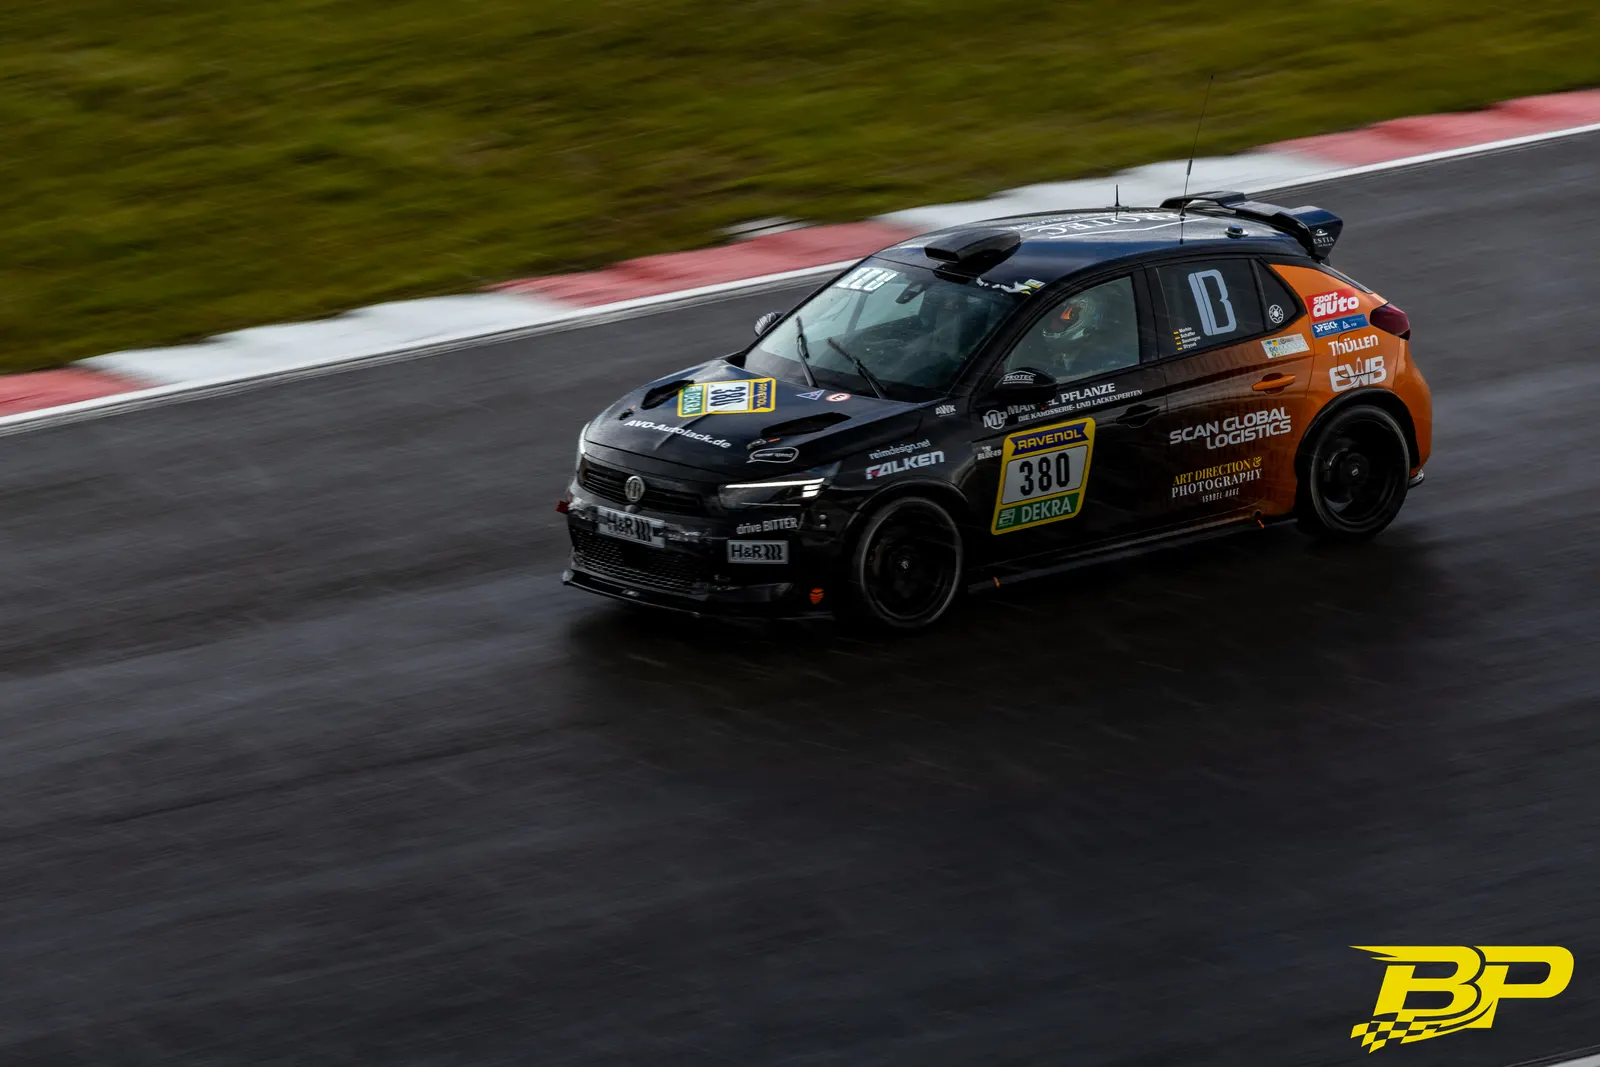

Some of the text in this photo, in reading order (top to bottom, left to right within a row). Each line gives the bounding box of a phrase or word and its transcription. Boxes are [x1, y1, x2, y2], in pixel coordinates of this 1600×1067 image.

[1312, 296, 1360, 318] auto
[1313, 291, 1338, 305] sport
[710, 386, 747, 407] 380
[1060, 383, 1116, 403] PFLANZE
[1076, 399, 1091, 409] UND
[1169, 407, 1291, 445] SCAN GLOBAL
[1206, 420, 1292, 450] LOGISTICS
[869, 439, 931, 460] reimdesign.net
[1018, 429, 1082, 450] RAVENOL
[865, 450, 945, 480] FALKEN
[1019, 452, 1069, 496] 380
[1173, 472, 1193, 486] ART
[1194, 459, 1251, 481] DIRECTION
[1171, 468, 1263, 499] PHOTOGRAPHY
[1021, 496, 1072, 522] DEKRA
[736, 517, 798, 535] drive BITTER
[731, 544, 760, 559] H&R
